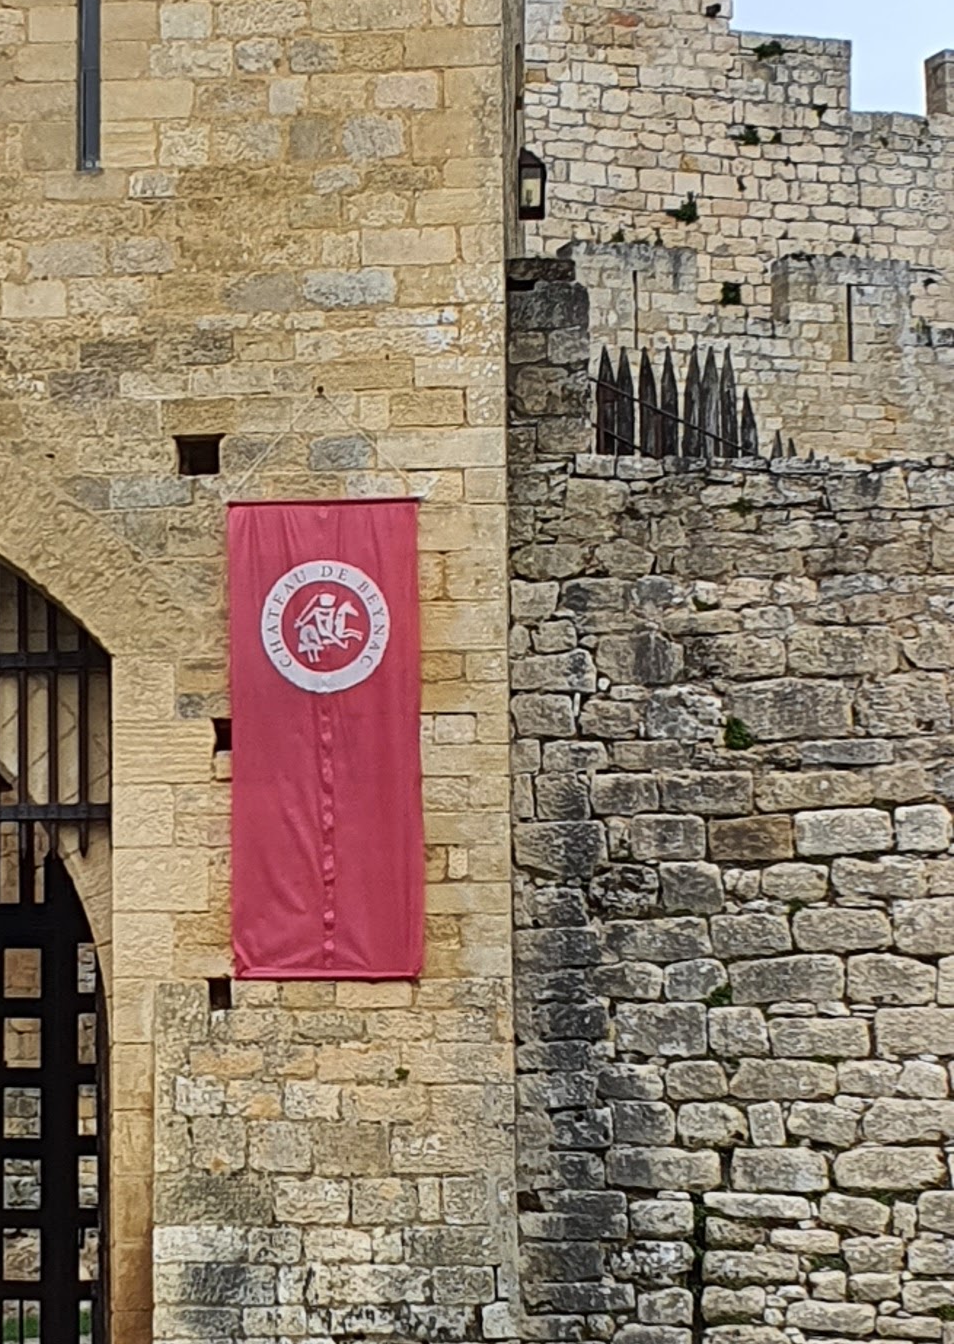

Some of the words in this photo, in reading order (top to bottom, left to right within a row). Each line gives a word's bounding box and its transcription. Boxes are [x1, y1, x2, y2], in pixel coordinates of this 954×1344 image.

[267, 570, 306, 669] CHATEAU
[321, 565, 349, 581] DE
[357, 581, 385, 669] BEYNAC
